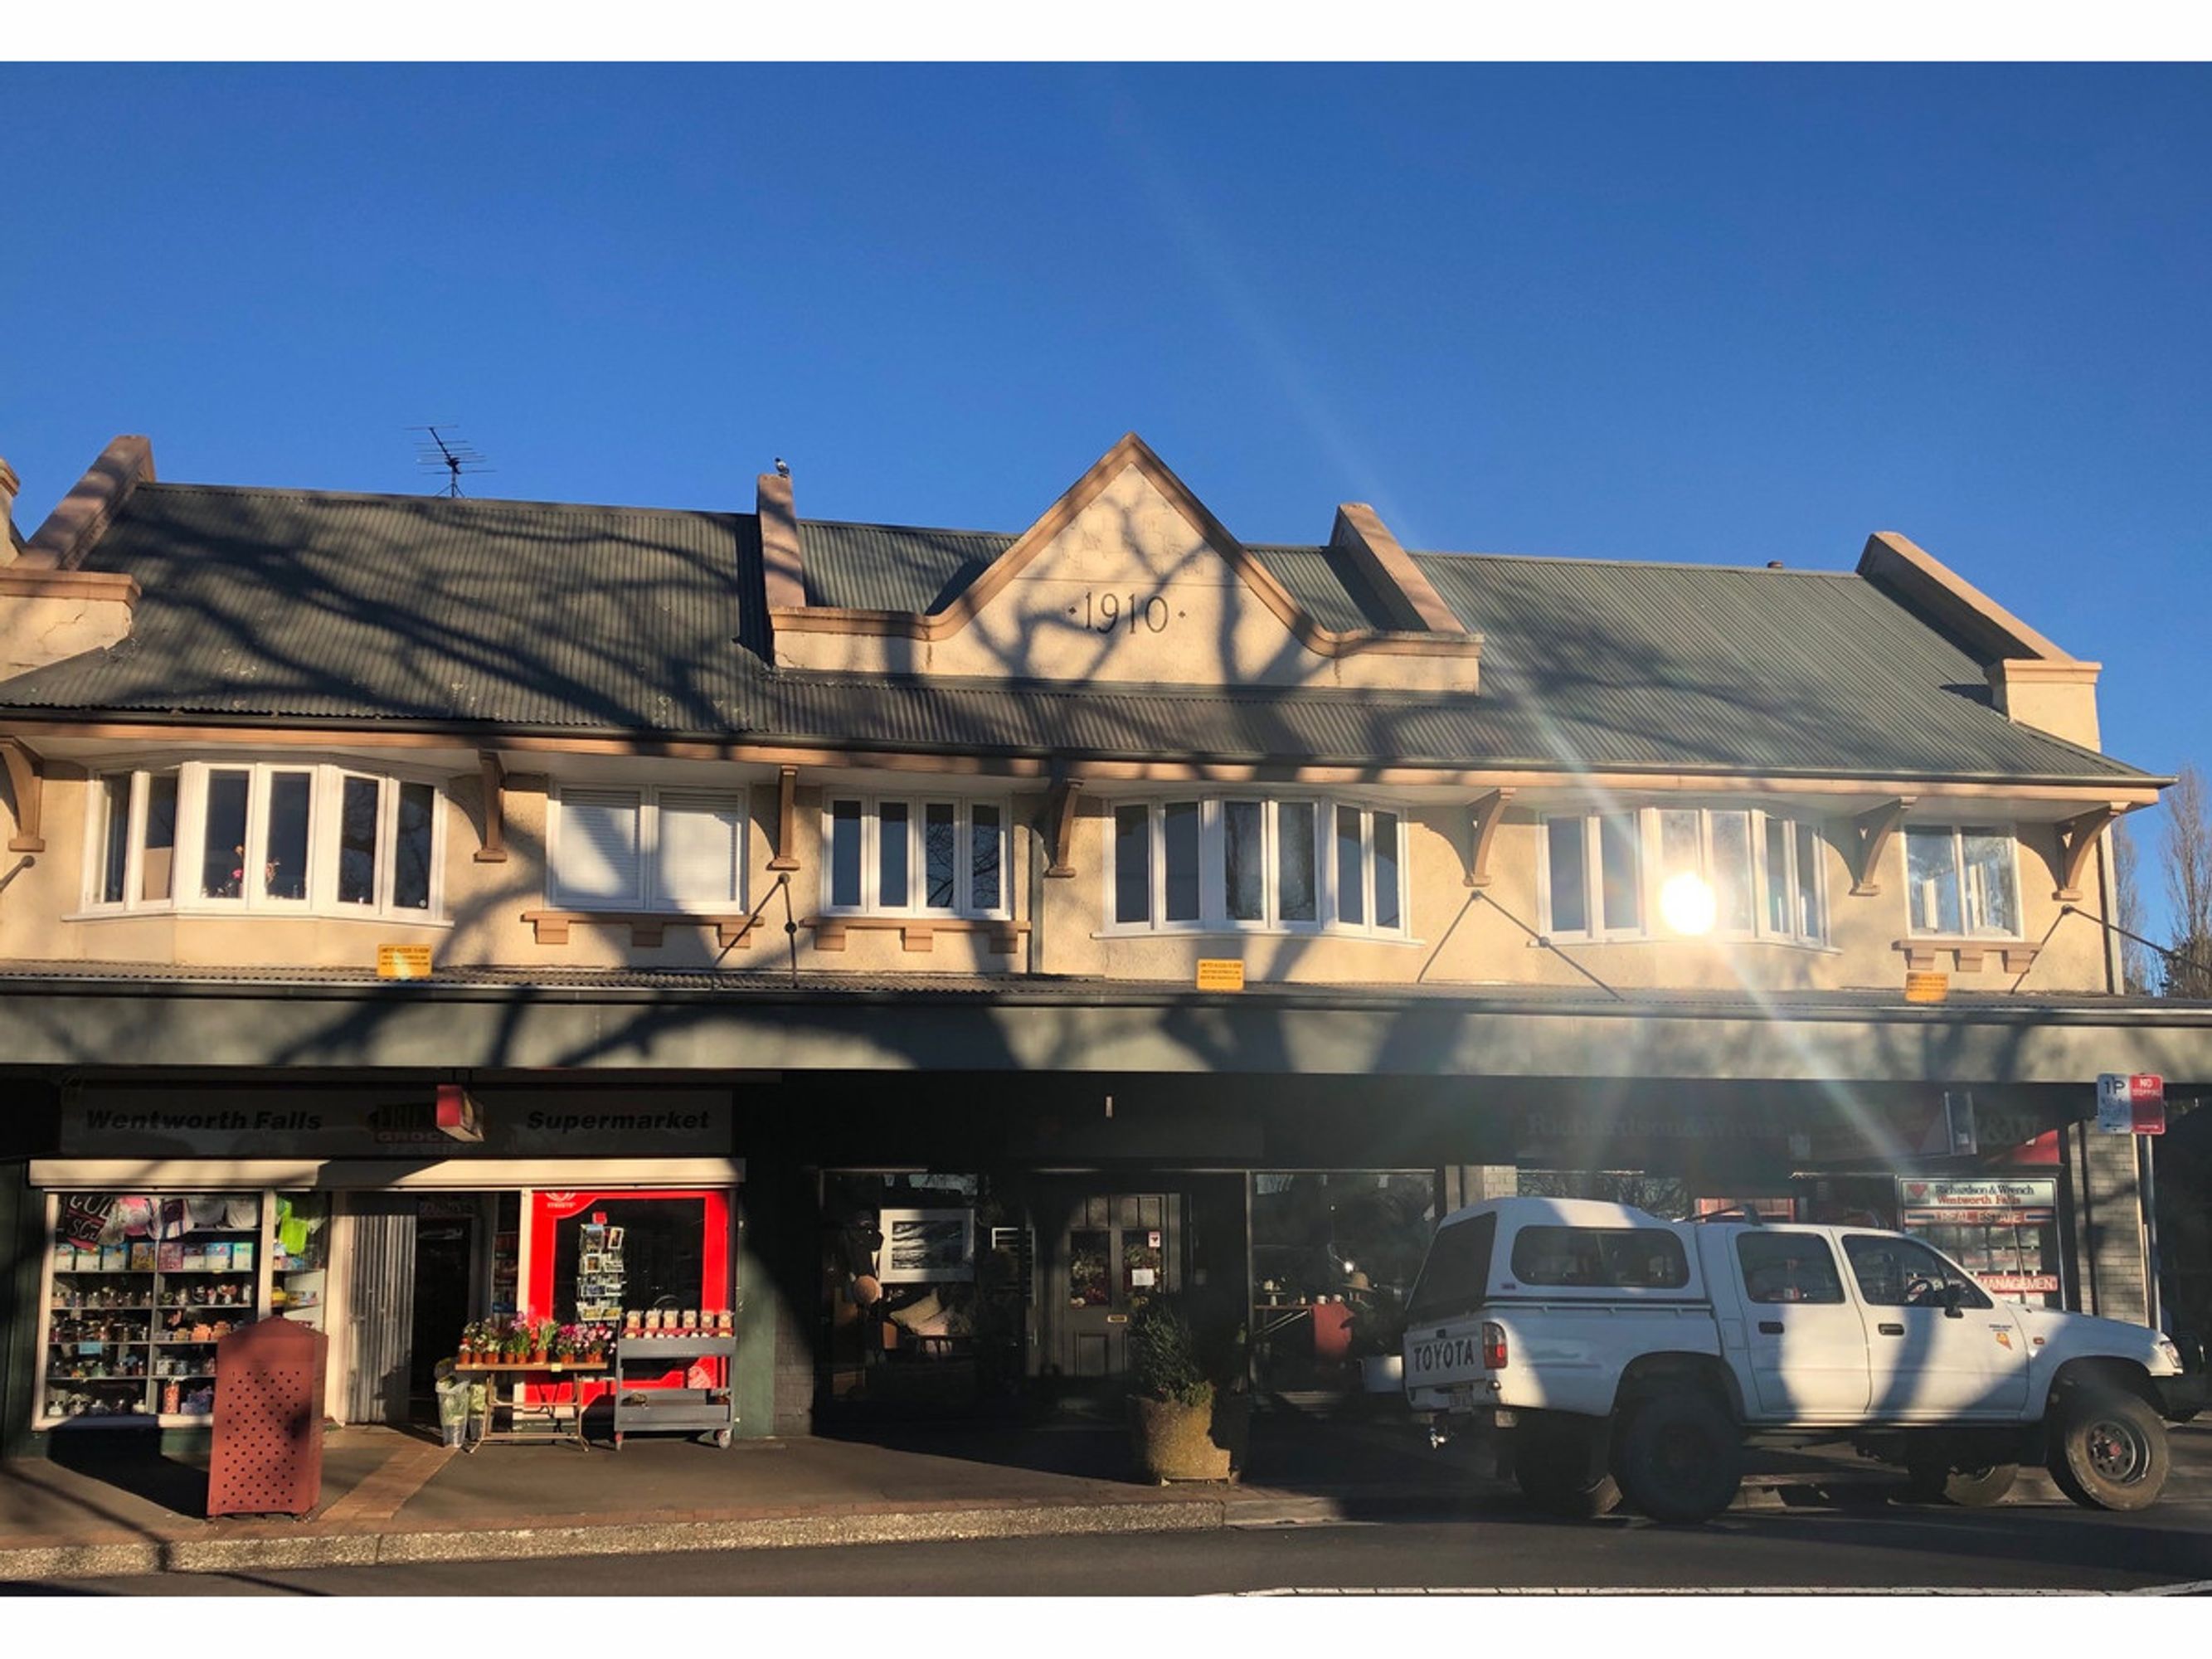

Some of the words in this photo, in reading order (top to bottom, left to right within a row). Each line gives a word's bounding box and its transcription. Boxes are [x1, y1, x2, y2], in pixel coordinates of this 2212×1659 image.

[1085, 591, 1169, 634] 1910
[2104, 1080, 2126, 1094] 1P
[2139, 1078, 2154, 1088] NO
[86, 1109, 246, 1129] Wentworth
[252, 1112, 322, 1129] Falls
[527, 1110, 710, 1133] Supermarket
[1935, 1184, 1987, 1194] Richardson
[1997, 1185, 2035, 1195] Wrench
[1937, 1194, 1991, 1204] Wentworth
[1978, 1212, 2024, 1223] ESTATE
[1413, 1339, 1474, 1373] TOYOTA
